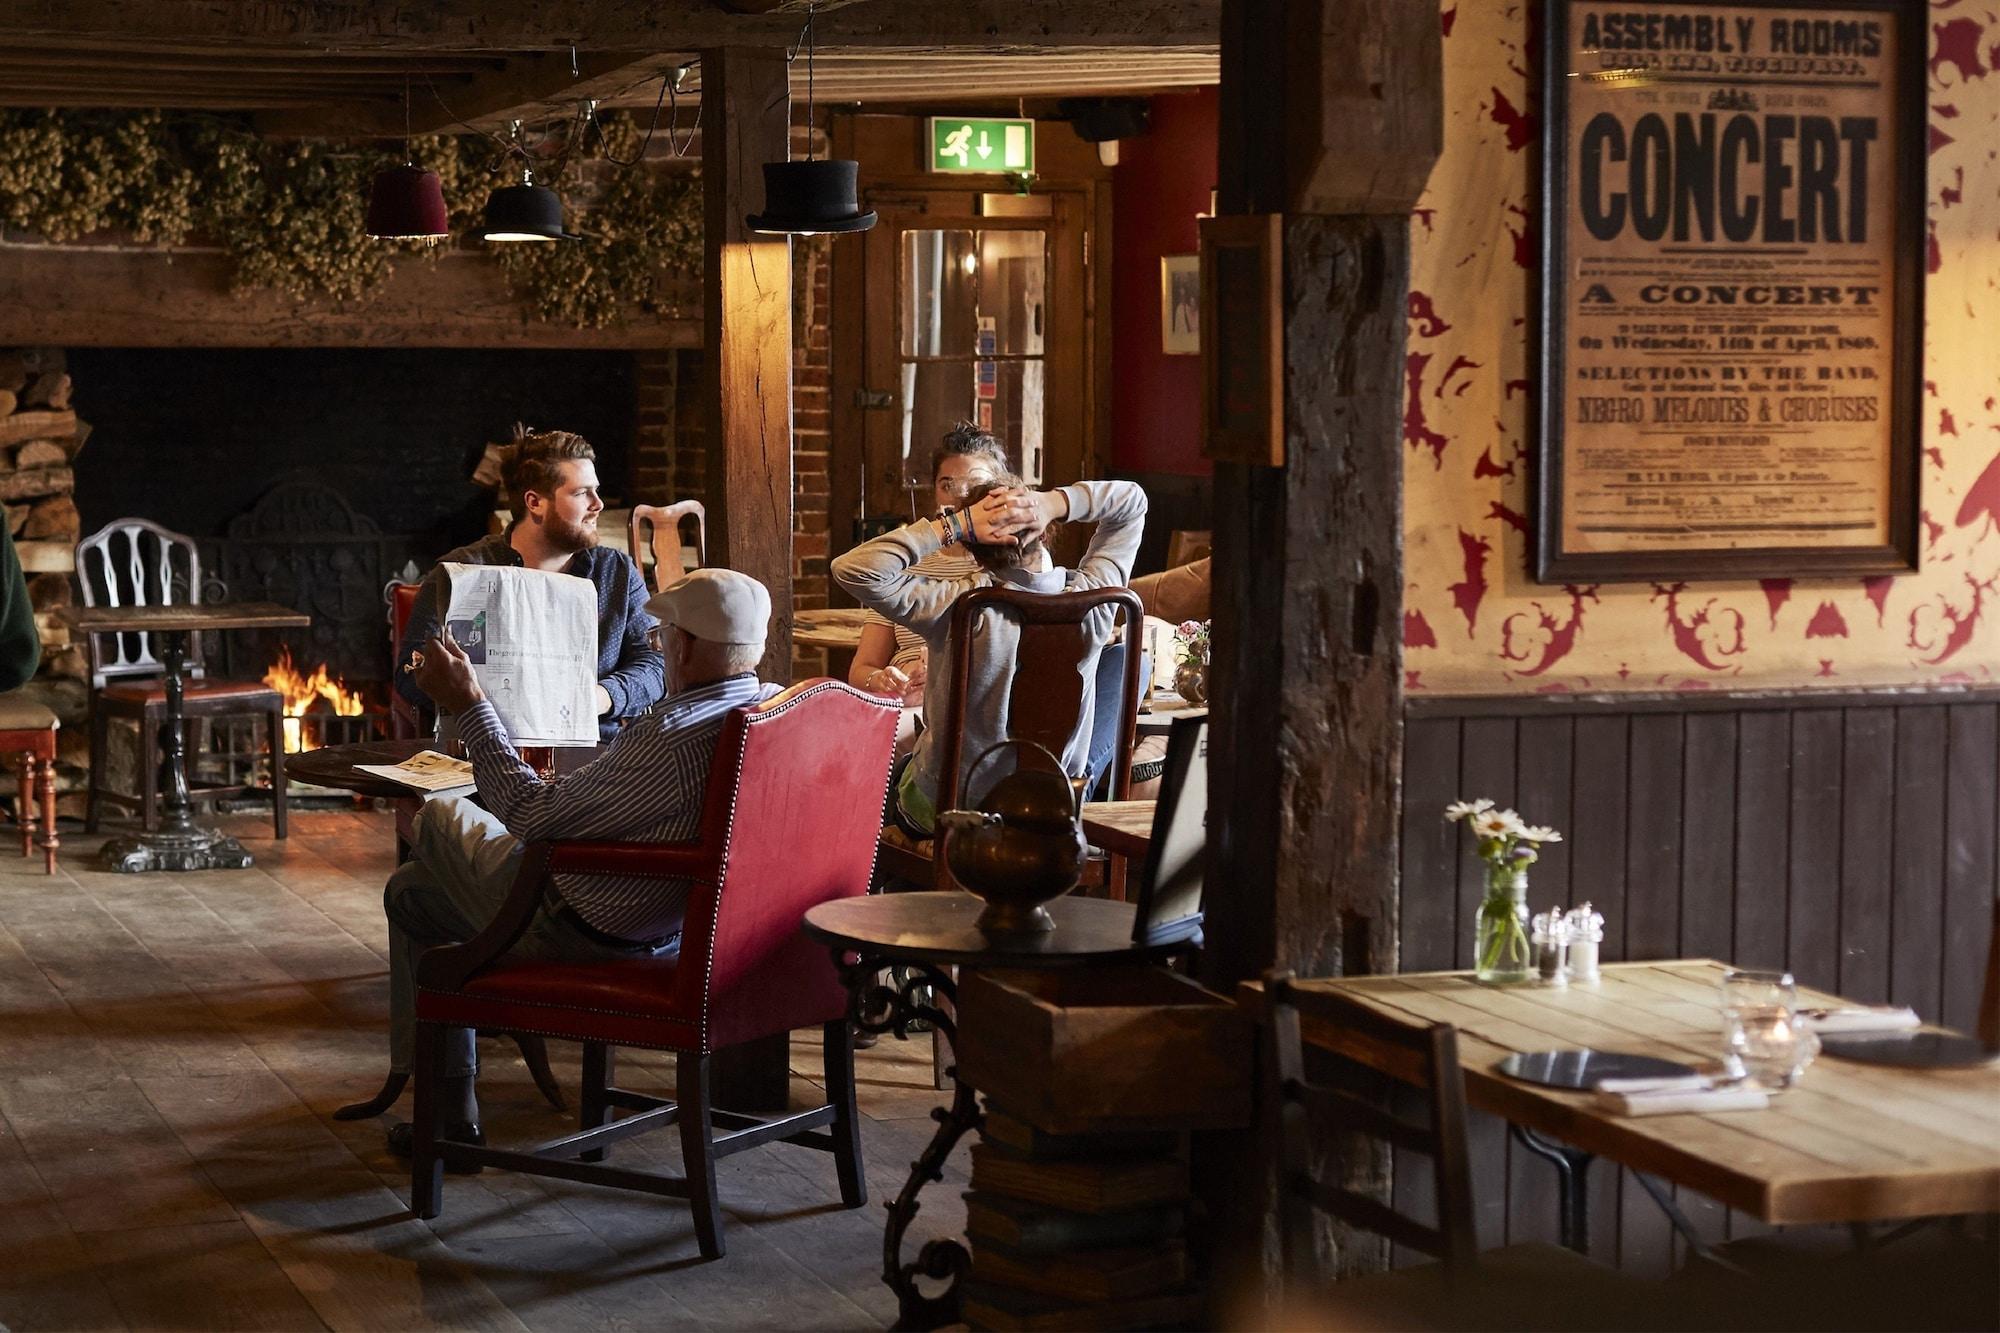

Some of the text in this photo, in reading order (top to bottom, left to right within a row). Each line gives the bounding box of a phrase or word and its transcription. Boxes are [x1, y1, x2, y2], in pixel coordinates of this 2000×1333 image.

[1582, 12, 1881, 57] ASSEMBLY ROOMS
[1580, 111, 1879, 244] CONCERT
[1579, 283, 1879, 305] A CONCERT
[1579, 337, 1603, 349] On
[1761, 337, 1778, 350] of
[1578, 367, 1711, 380] SELECTIONS
[1722, 367, 1749, 380] BY
[1763, 367, 1807, 380] THE
[1577, 396, 1879, 423] NEGRO MELODIES & CHORUSES
